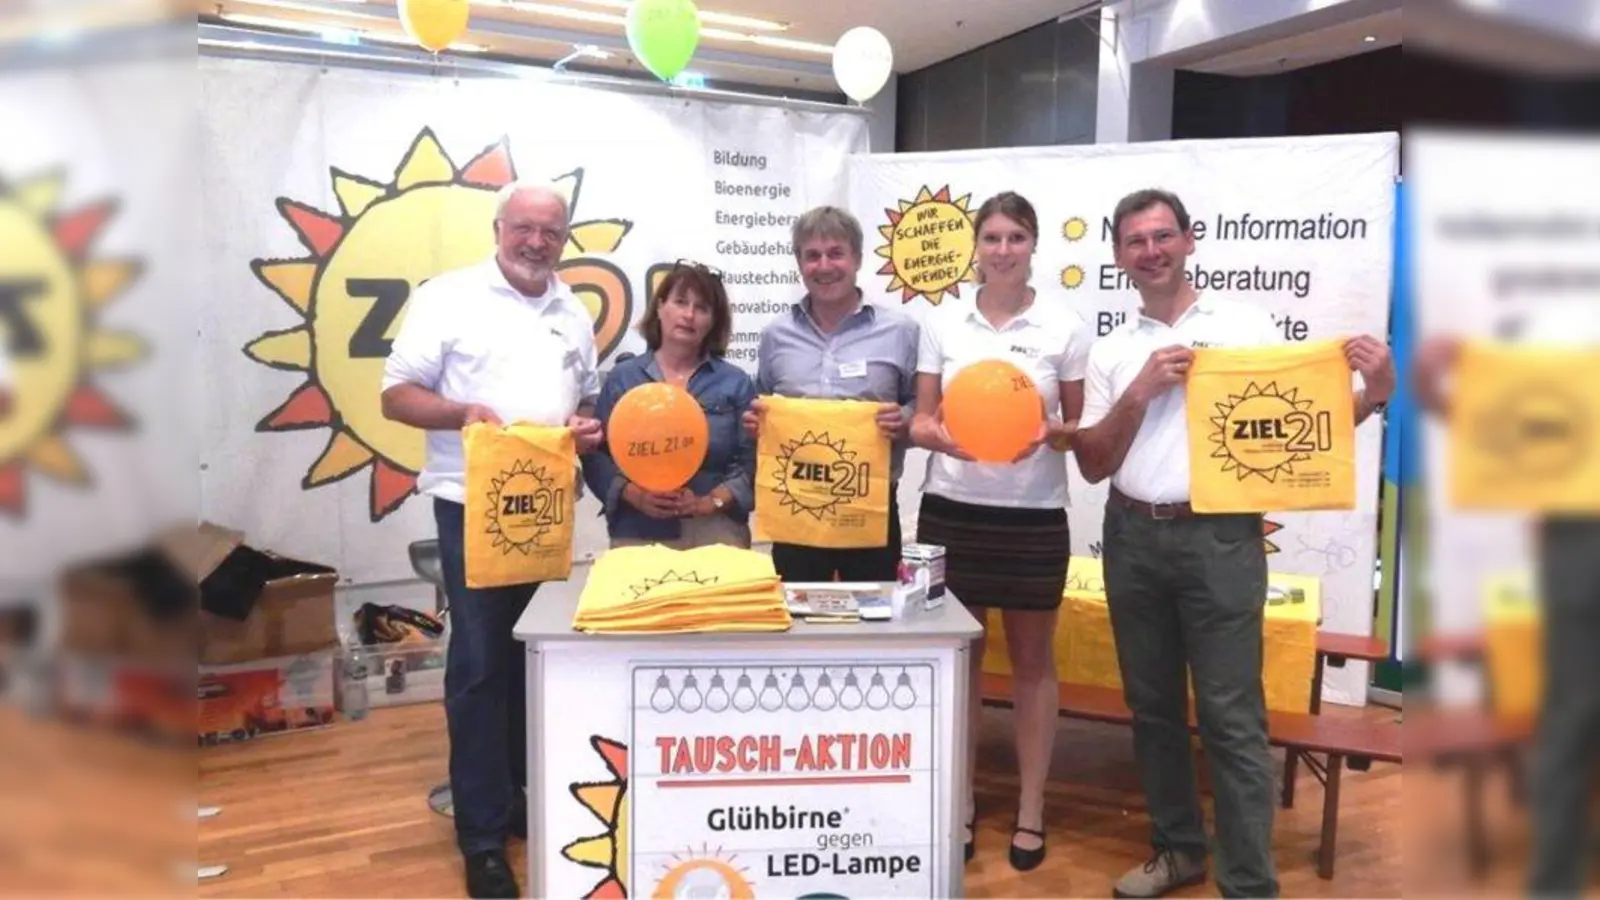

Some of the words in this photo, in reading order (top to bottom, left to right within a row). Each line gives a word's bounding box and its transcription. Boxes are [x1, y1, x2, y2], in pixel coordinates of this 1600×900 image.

[713, 150, 767, 170] Bildung
[714, 180, 791, 200] Bioenergie
[916, 207, 938, 222] WIR
[896, 218, 964, 241] SCHAFFEN
[1216, 213, 1367, 241] Information
[921, 237, 941, 252] DIE
[903, 250, 962, 270] ENERGIE-
[911, 266, 959, 285] WENDE!
[628, 440, 661, 457] ZIEL
[655, 733, 912, 774] TAUSCH-AKTION
[817, 831, 874, 850] gegen
[767, 853, 921, 879] LED-Lampe
